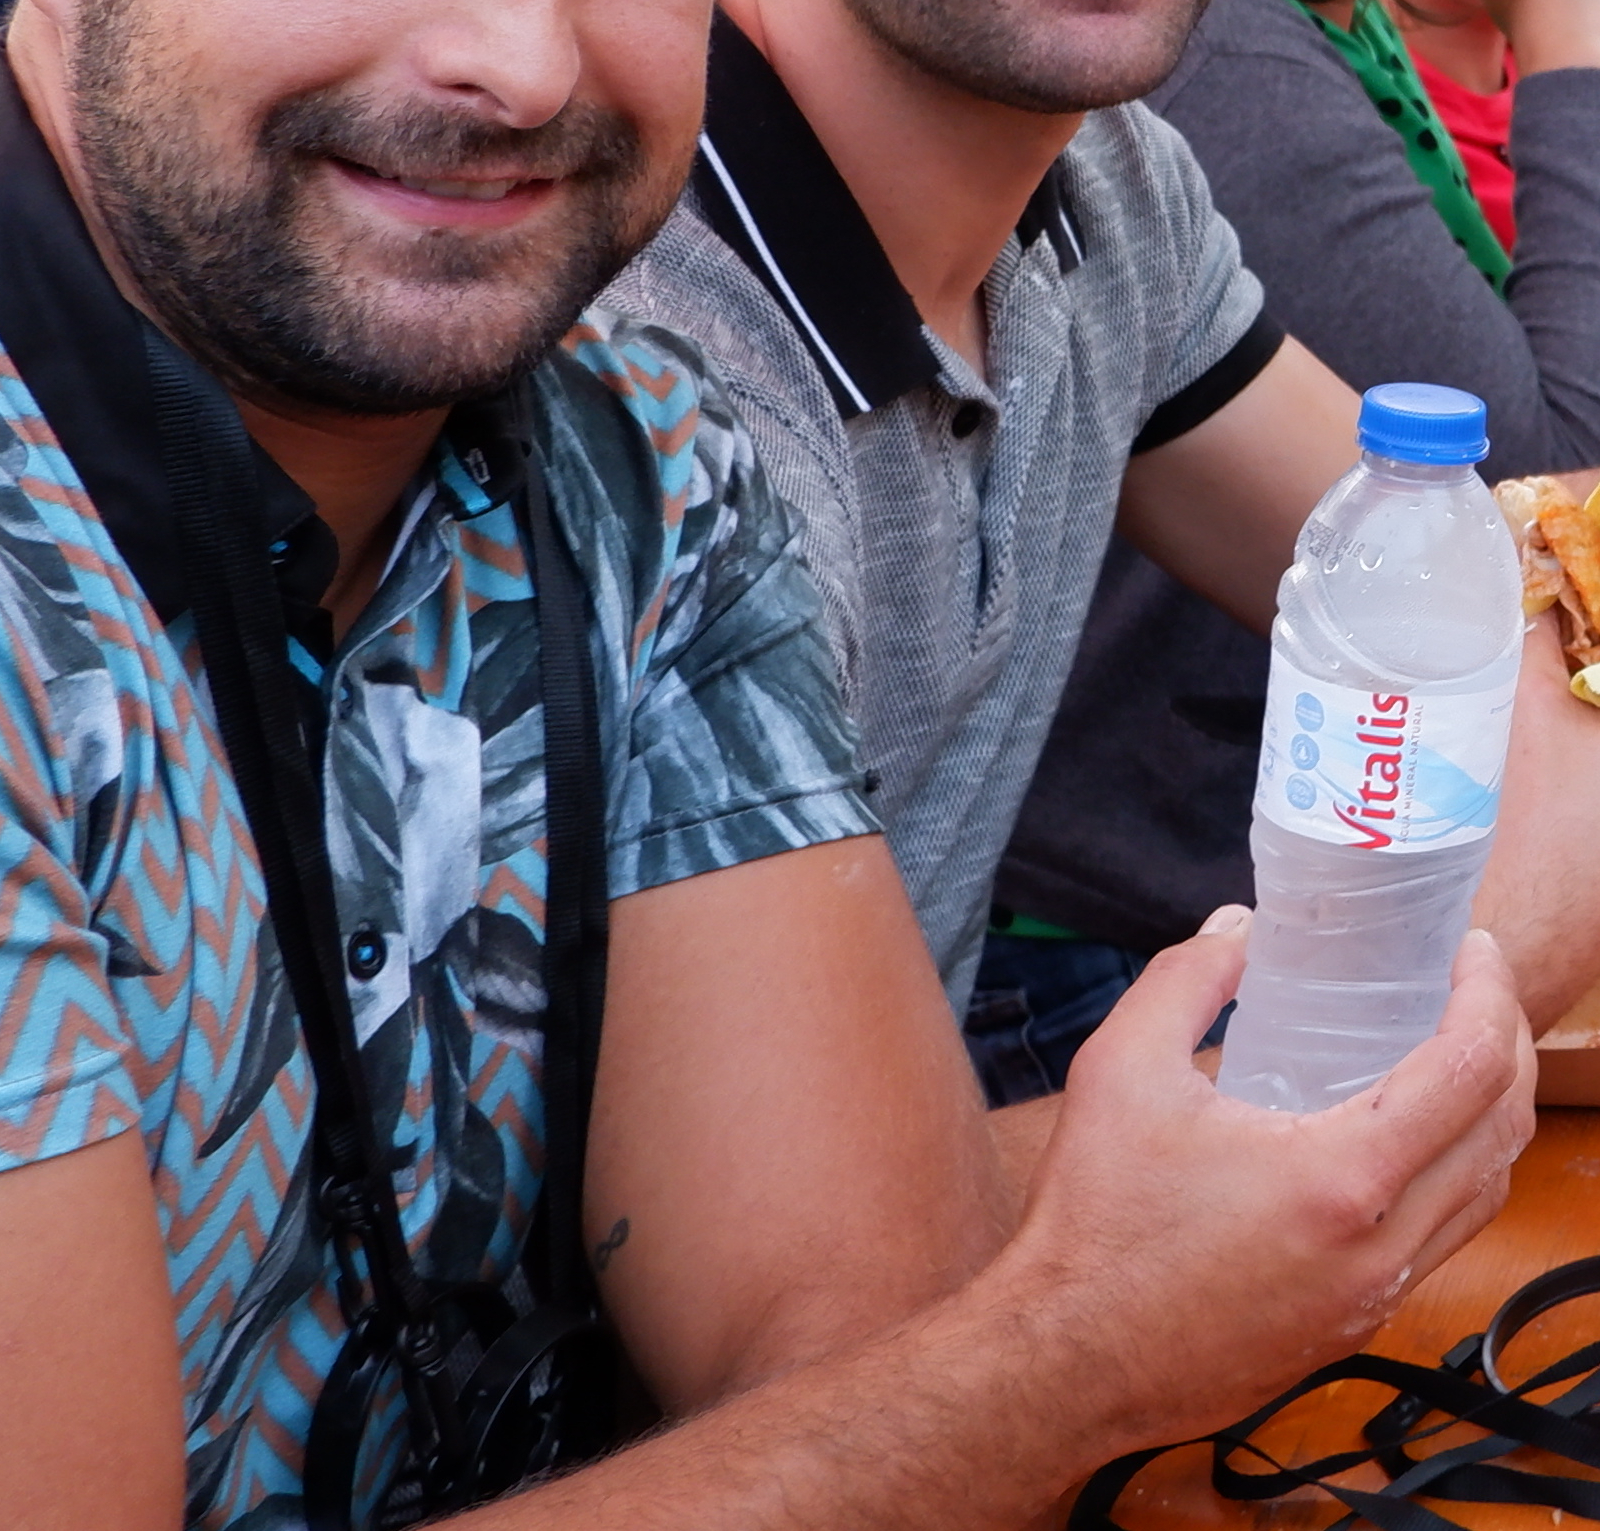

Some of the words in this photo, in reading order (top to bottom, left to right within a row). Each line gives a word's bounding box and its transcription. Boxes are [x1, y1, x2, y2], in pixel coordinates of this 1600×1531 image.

[1410, 704, 1424, 756] NATURAL
[1332, 693, 1410, 850] Vitalis
[1403, 759, 1418, 810] MINERAL
